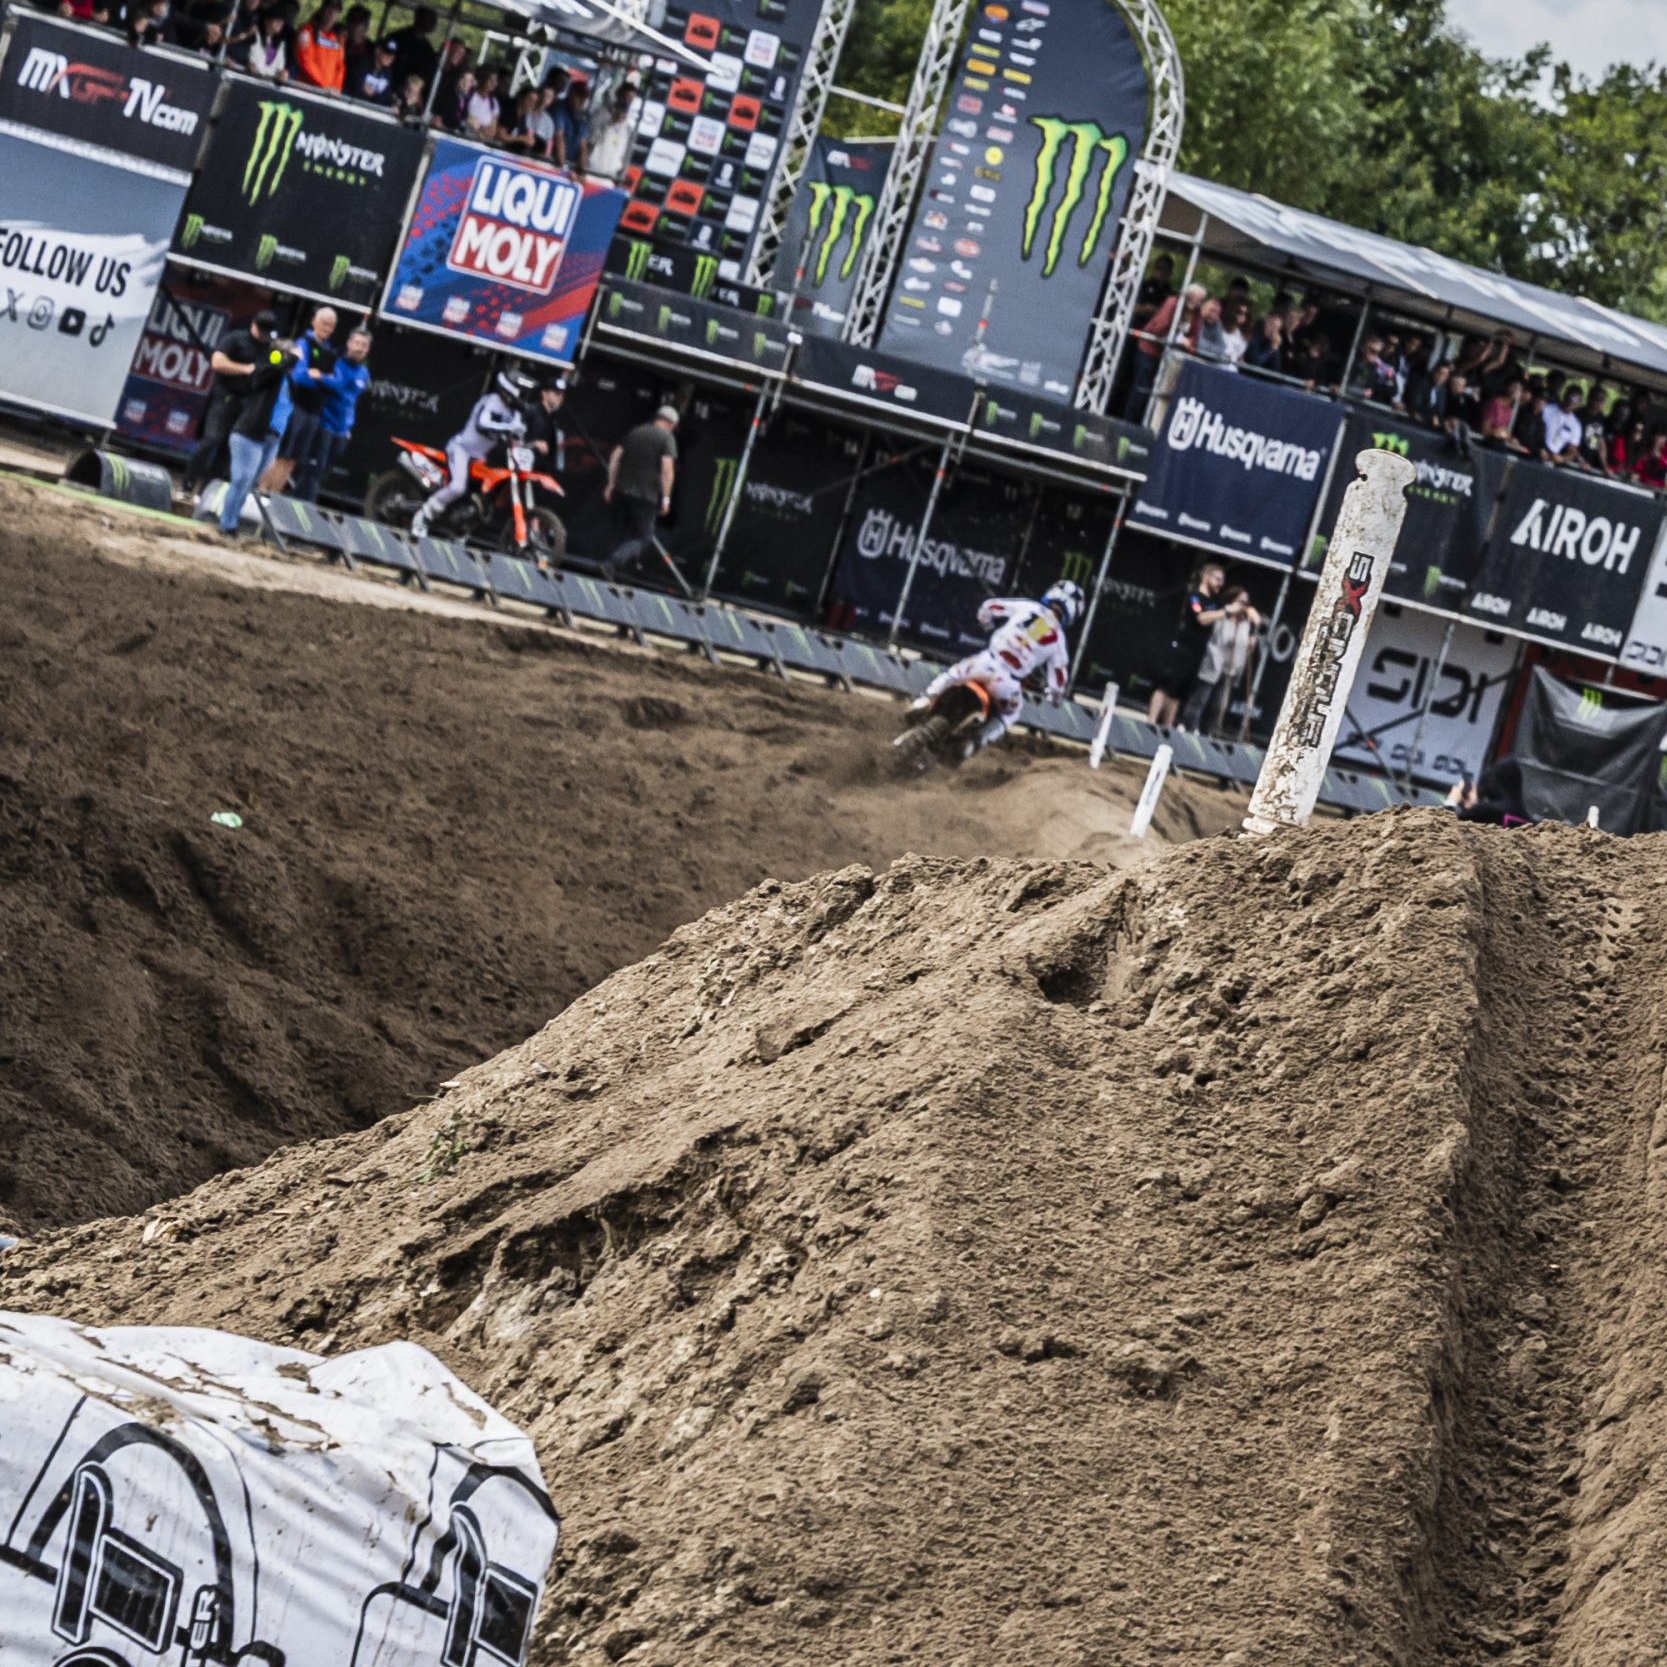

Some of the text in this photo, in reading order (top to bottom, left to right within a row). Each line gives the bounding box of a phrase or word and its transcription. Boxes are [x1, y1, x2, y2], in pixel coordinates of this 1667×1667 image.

[295, 131, 385, 177] MONSTER
[471, 164, 579, 234] LIQUI
[95, 257, 131, 297] US
[455, 218, 562, 286] MOLY
[134, 337, 210, 387] MOLY
[1195, 410, 1321, 482] Husqvarna
[1510, 498, 1641, 575] AIROH
